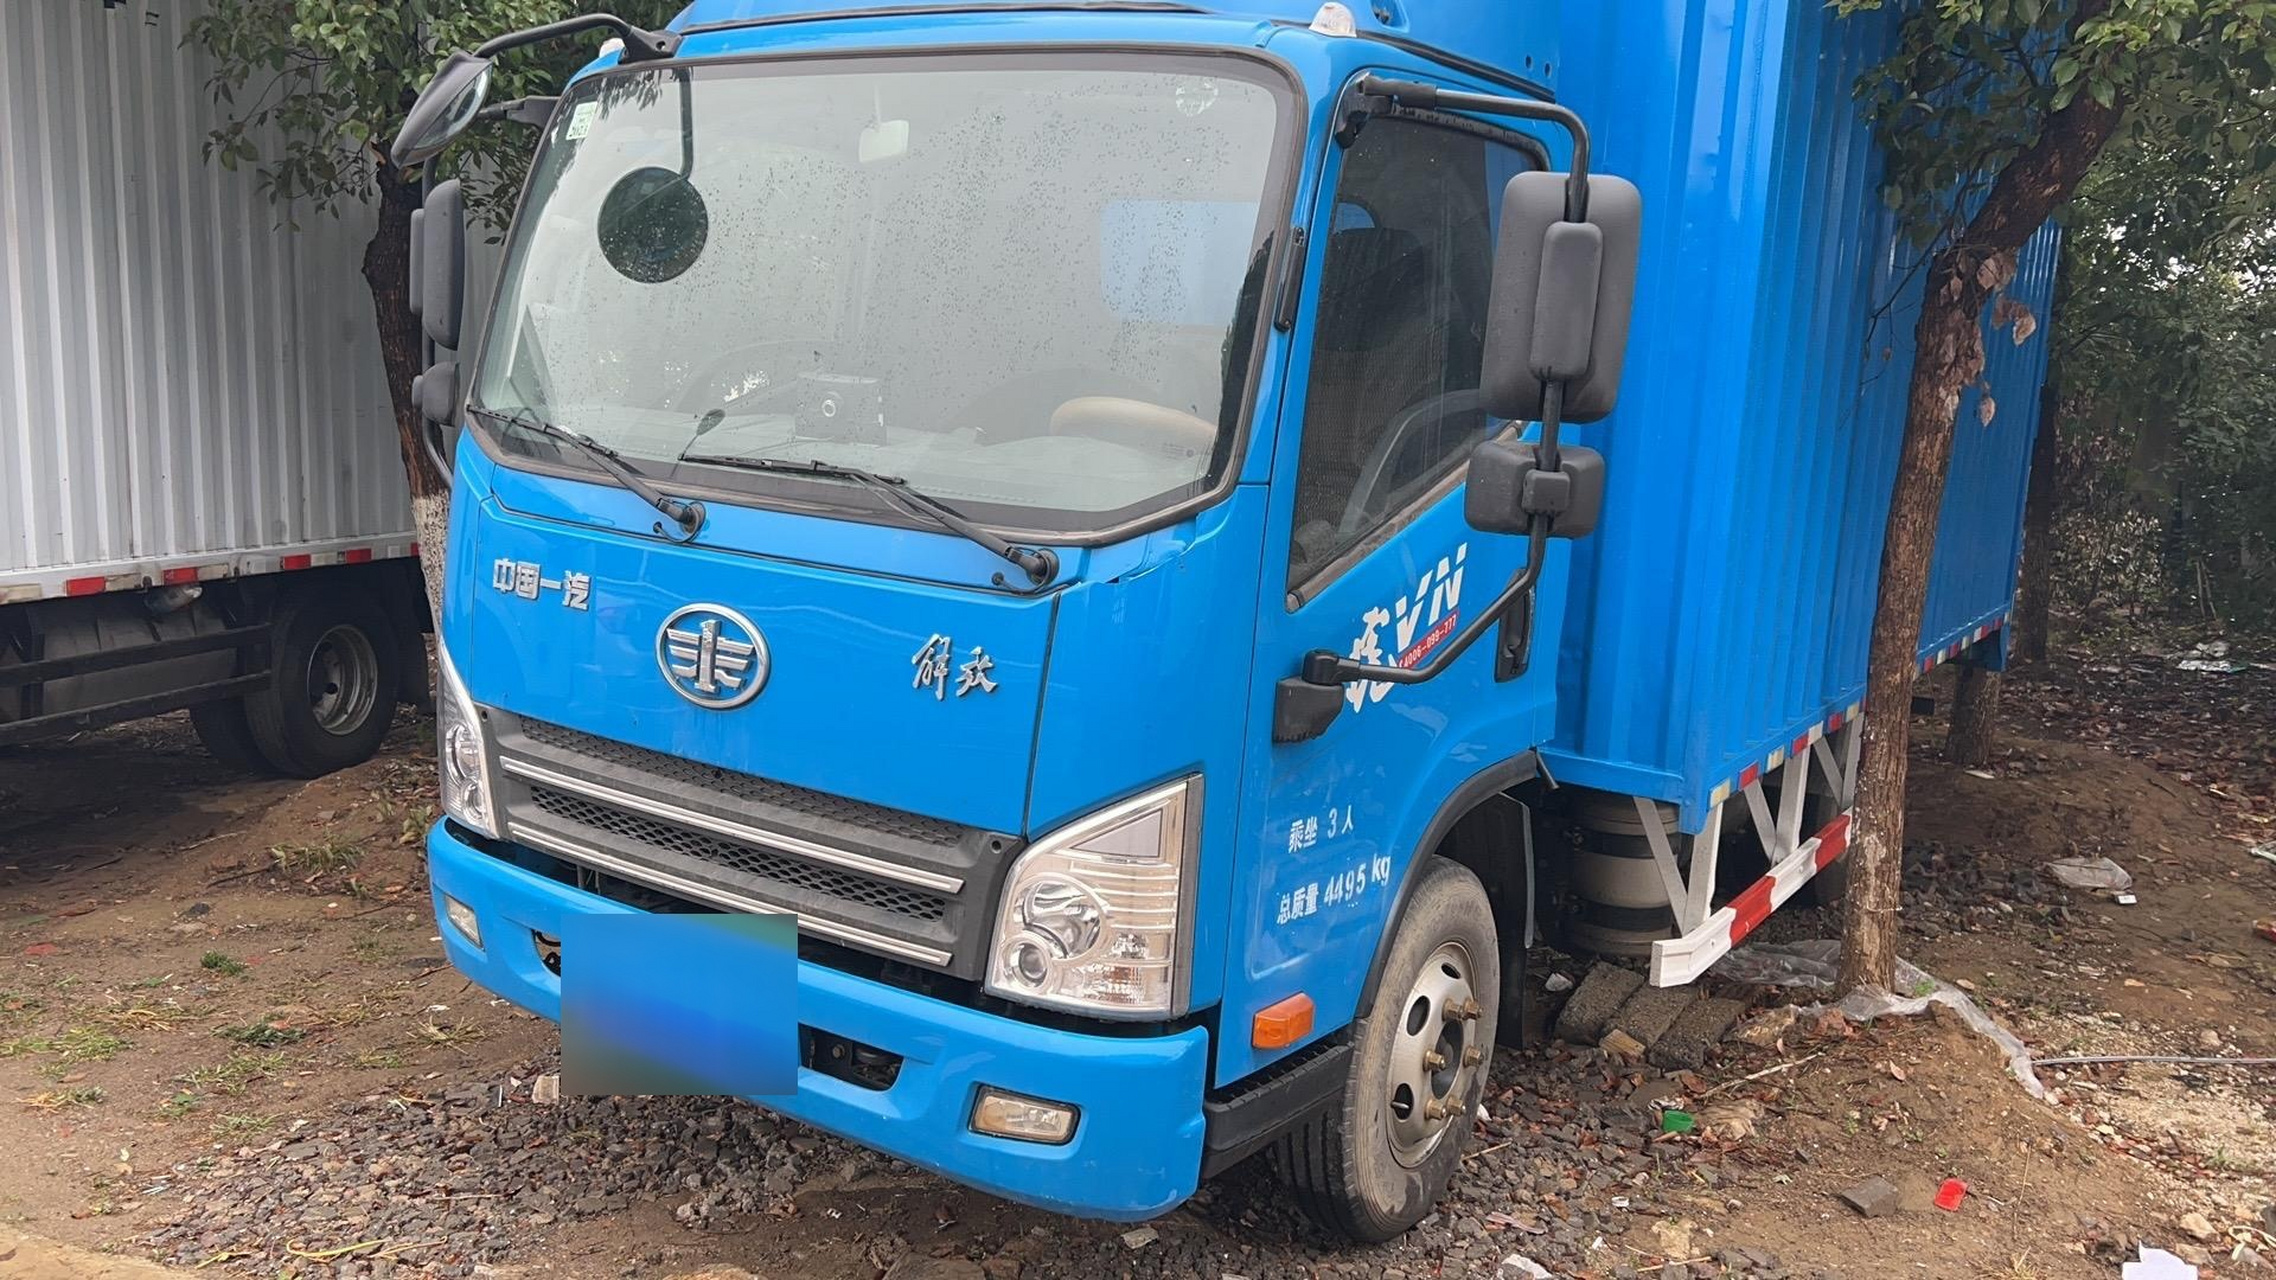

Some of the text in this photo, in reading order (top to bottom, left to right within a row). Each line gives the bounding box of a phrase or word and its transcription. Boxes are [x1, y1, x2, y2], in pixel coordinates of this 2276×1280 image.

[492, 557, 591, 611] 中国一汽
[910, 633, 998, 701] 解放
[1276, 853, 1391, 925] 总质量 4495 kg
